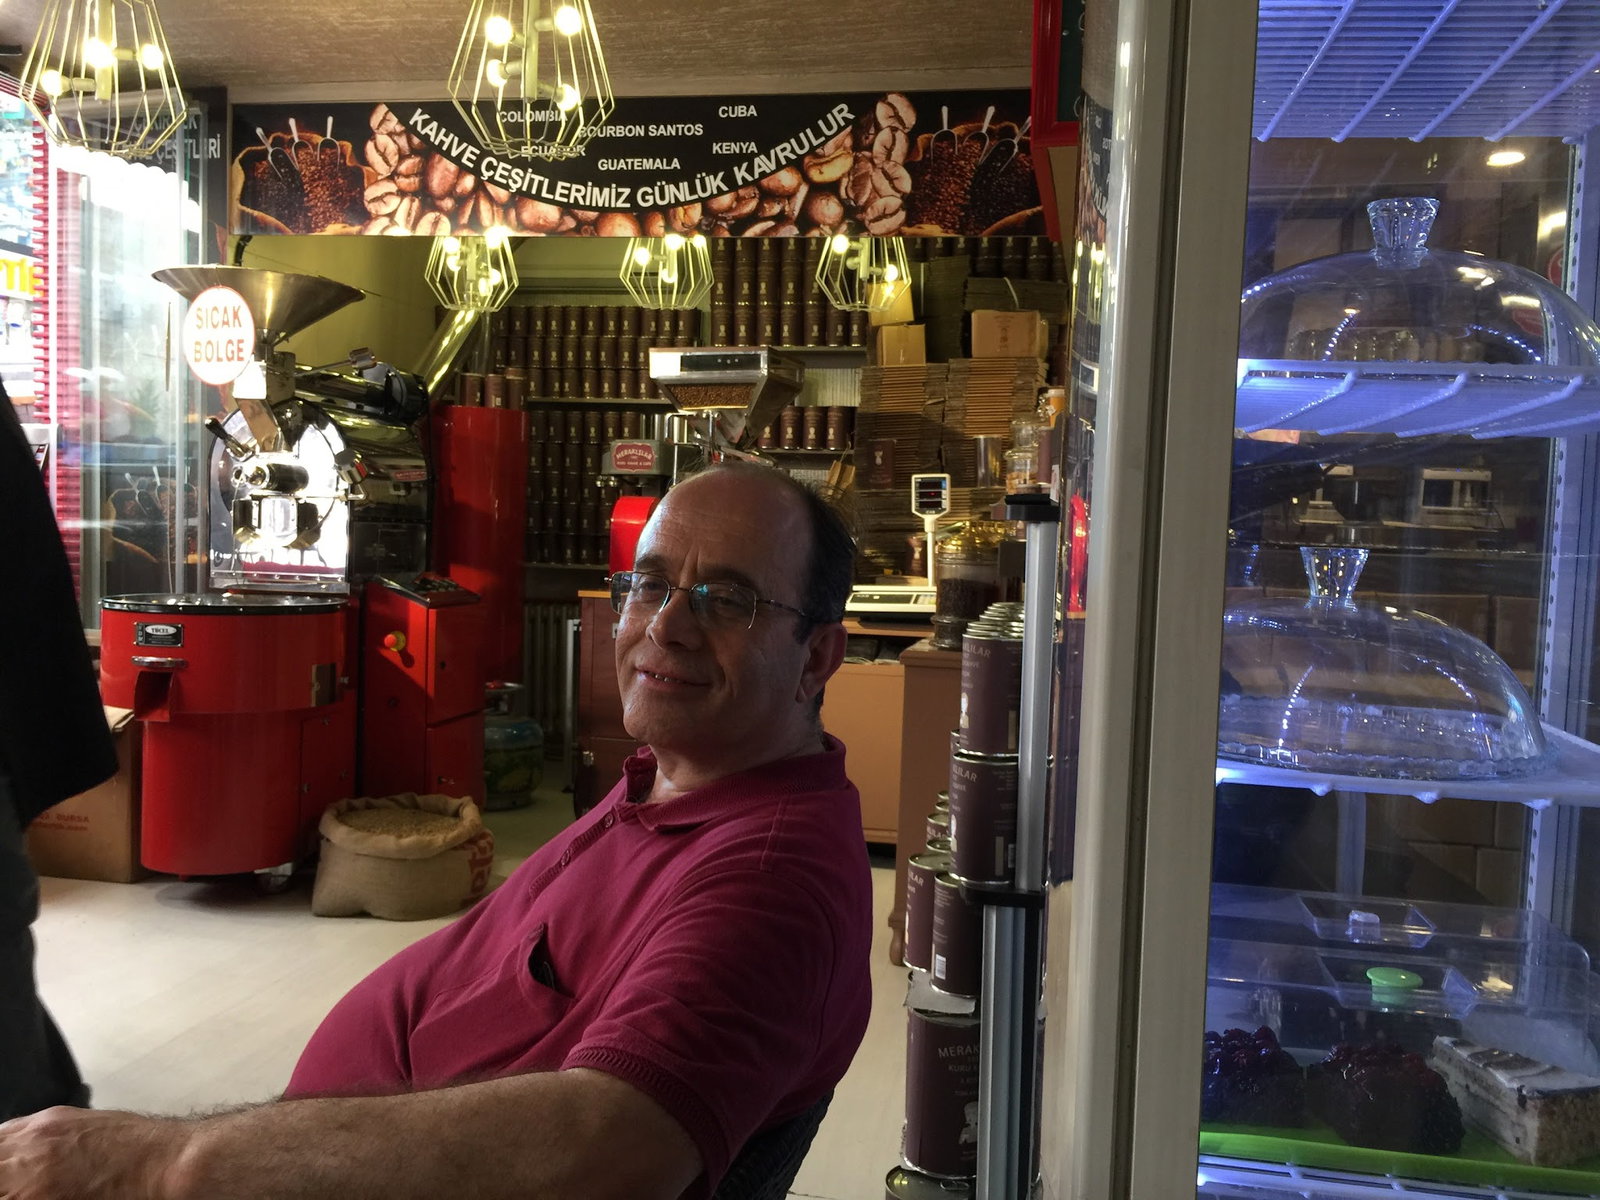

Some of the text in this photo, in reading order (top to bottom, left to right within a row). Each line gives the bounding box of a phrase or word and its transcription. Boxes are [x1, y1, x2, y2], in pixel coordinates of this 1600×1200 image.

[499, 110, 568, 123] COLOMBIA
[718, 105, 758, 118] CUBA
[578, 123, 704, 138] BOURBON SANTOS
[712, 141, 758, 155] KENYA
[409, 102, 856, 210] KAHVE ÇEŞİTLERİMİZ GÜNLÜK KAVRULUR
[598, 158, 681, 171] GUATEMALA
[195, 304, 243, 330] SICAK
